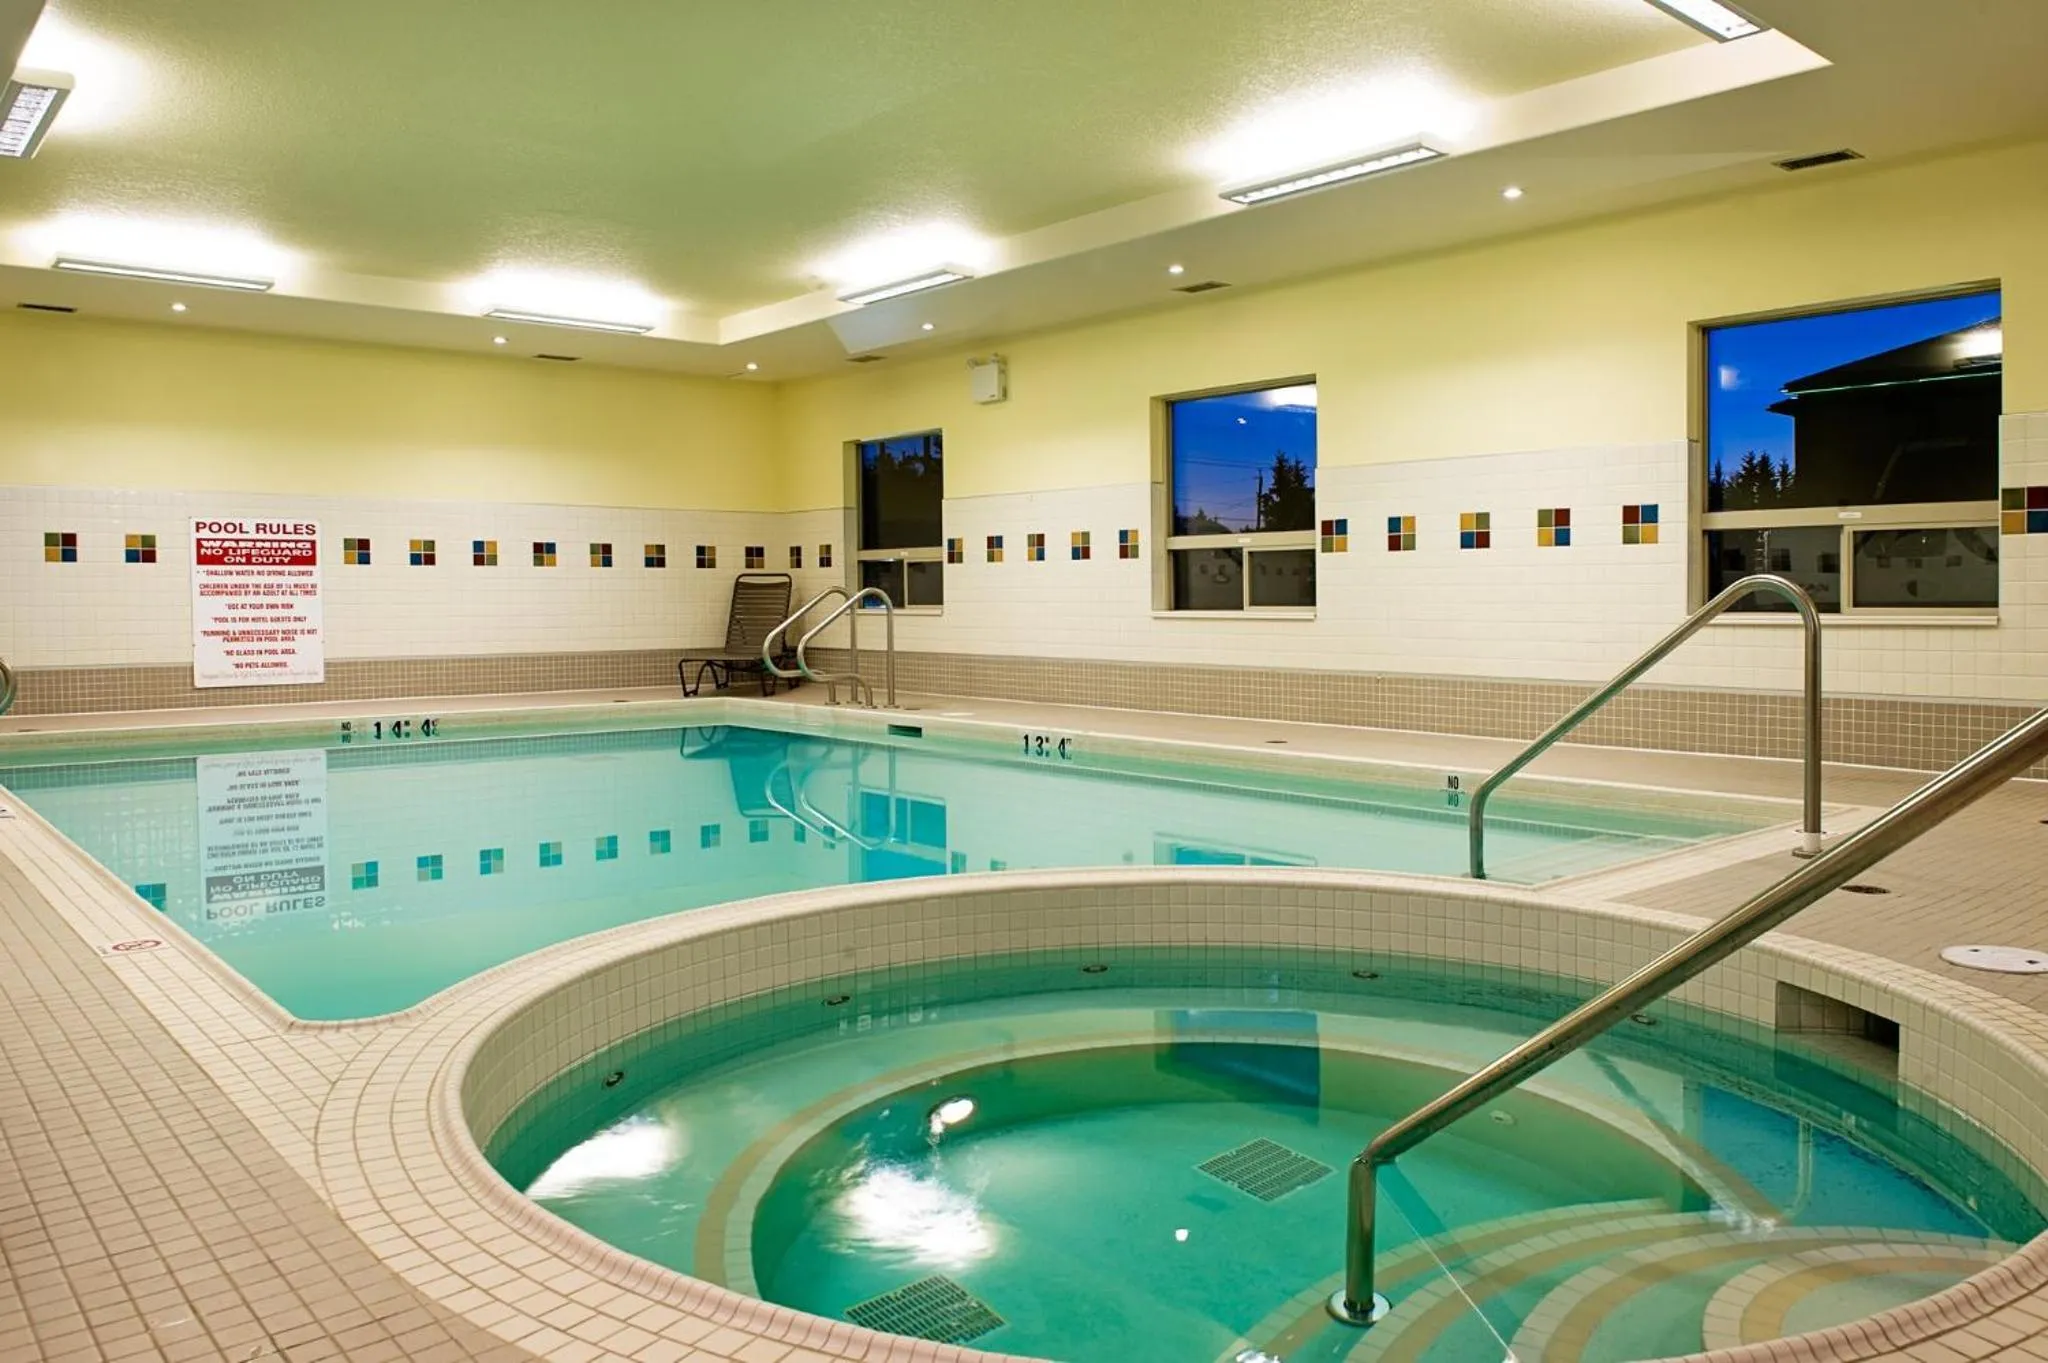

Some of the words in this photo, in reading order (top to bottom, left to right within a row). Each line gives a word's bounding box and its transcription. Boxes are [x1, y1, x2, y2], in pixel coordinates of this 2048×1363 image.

[195, 521, 250, 534] POOL
[255, 522, 316, 535] RULES
[200, 540, 312, 549] WARNING
[200, 548, 224, 556] NO
[228, 548, 313, 556] LIFEGUARD
[223, 556, 247, 564] ON
[251, 556, 292, 564] DUTY
[1447, 775, 1459, 790] NO
